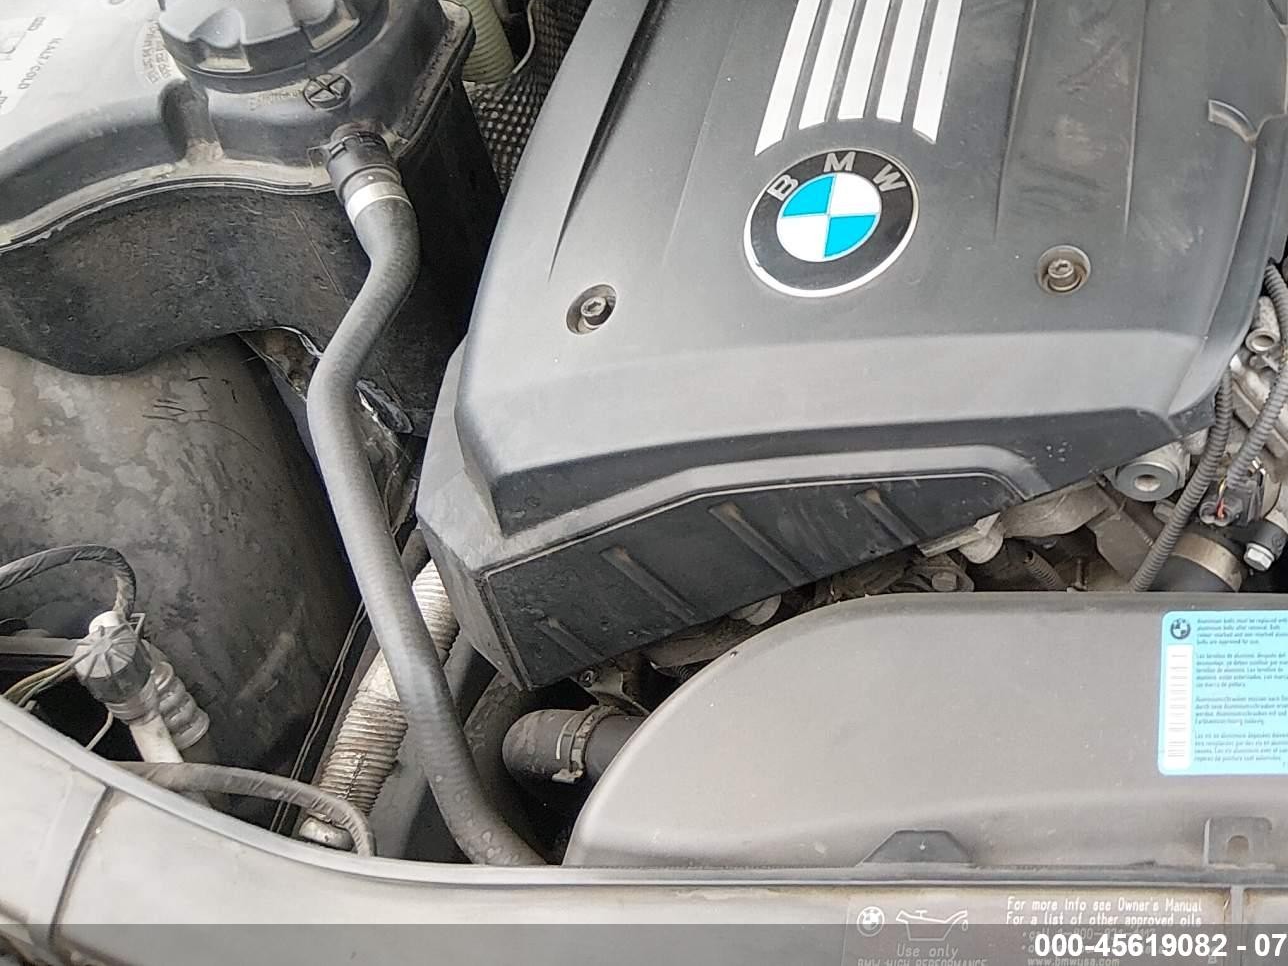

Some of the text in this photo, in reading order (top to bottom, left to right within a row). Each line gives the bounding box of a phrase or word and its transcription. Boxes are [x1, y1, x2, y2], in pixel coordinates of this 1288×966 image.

[767, 151, 907, 201] BMW
[1007, 896, 1202, 913] For more Info see Owner's Manual
[1006, 911, 1202, 928] For a list of other approved oils
[896, 943, 959, 960] Use only
